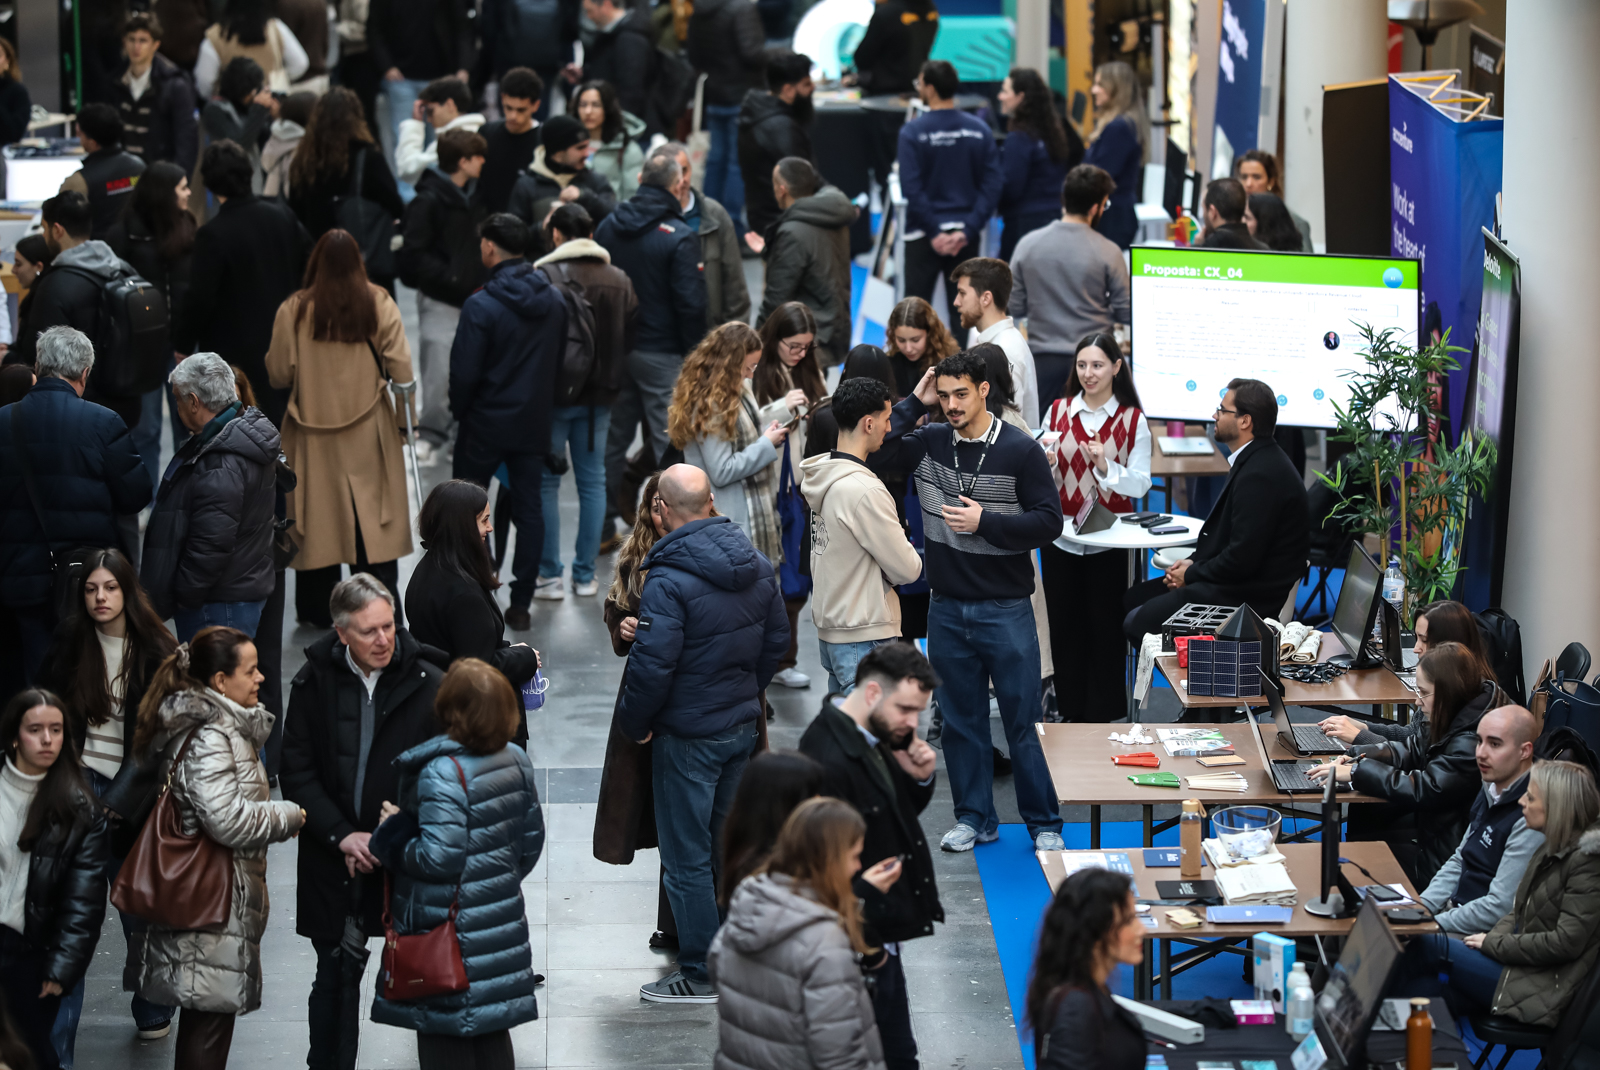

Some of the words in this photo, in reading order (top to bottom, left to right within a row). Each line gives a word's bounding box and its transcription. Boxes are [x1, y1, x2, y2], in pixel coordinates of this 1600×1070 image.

[1393, 182, 1407, 221] Work
[1408, 200, 1415, 226] at
[1393, 220, 1403, 254] the
[1143, 264, 1201, 277] Proposta:
[1204, 266, 1243, 280] CX_04
